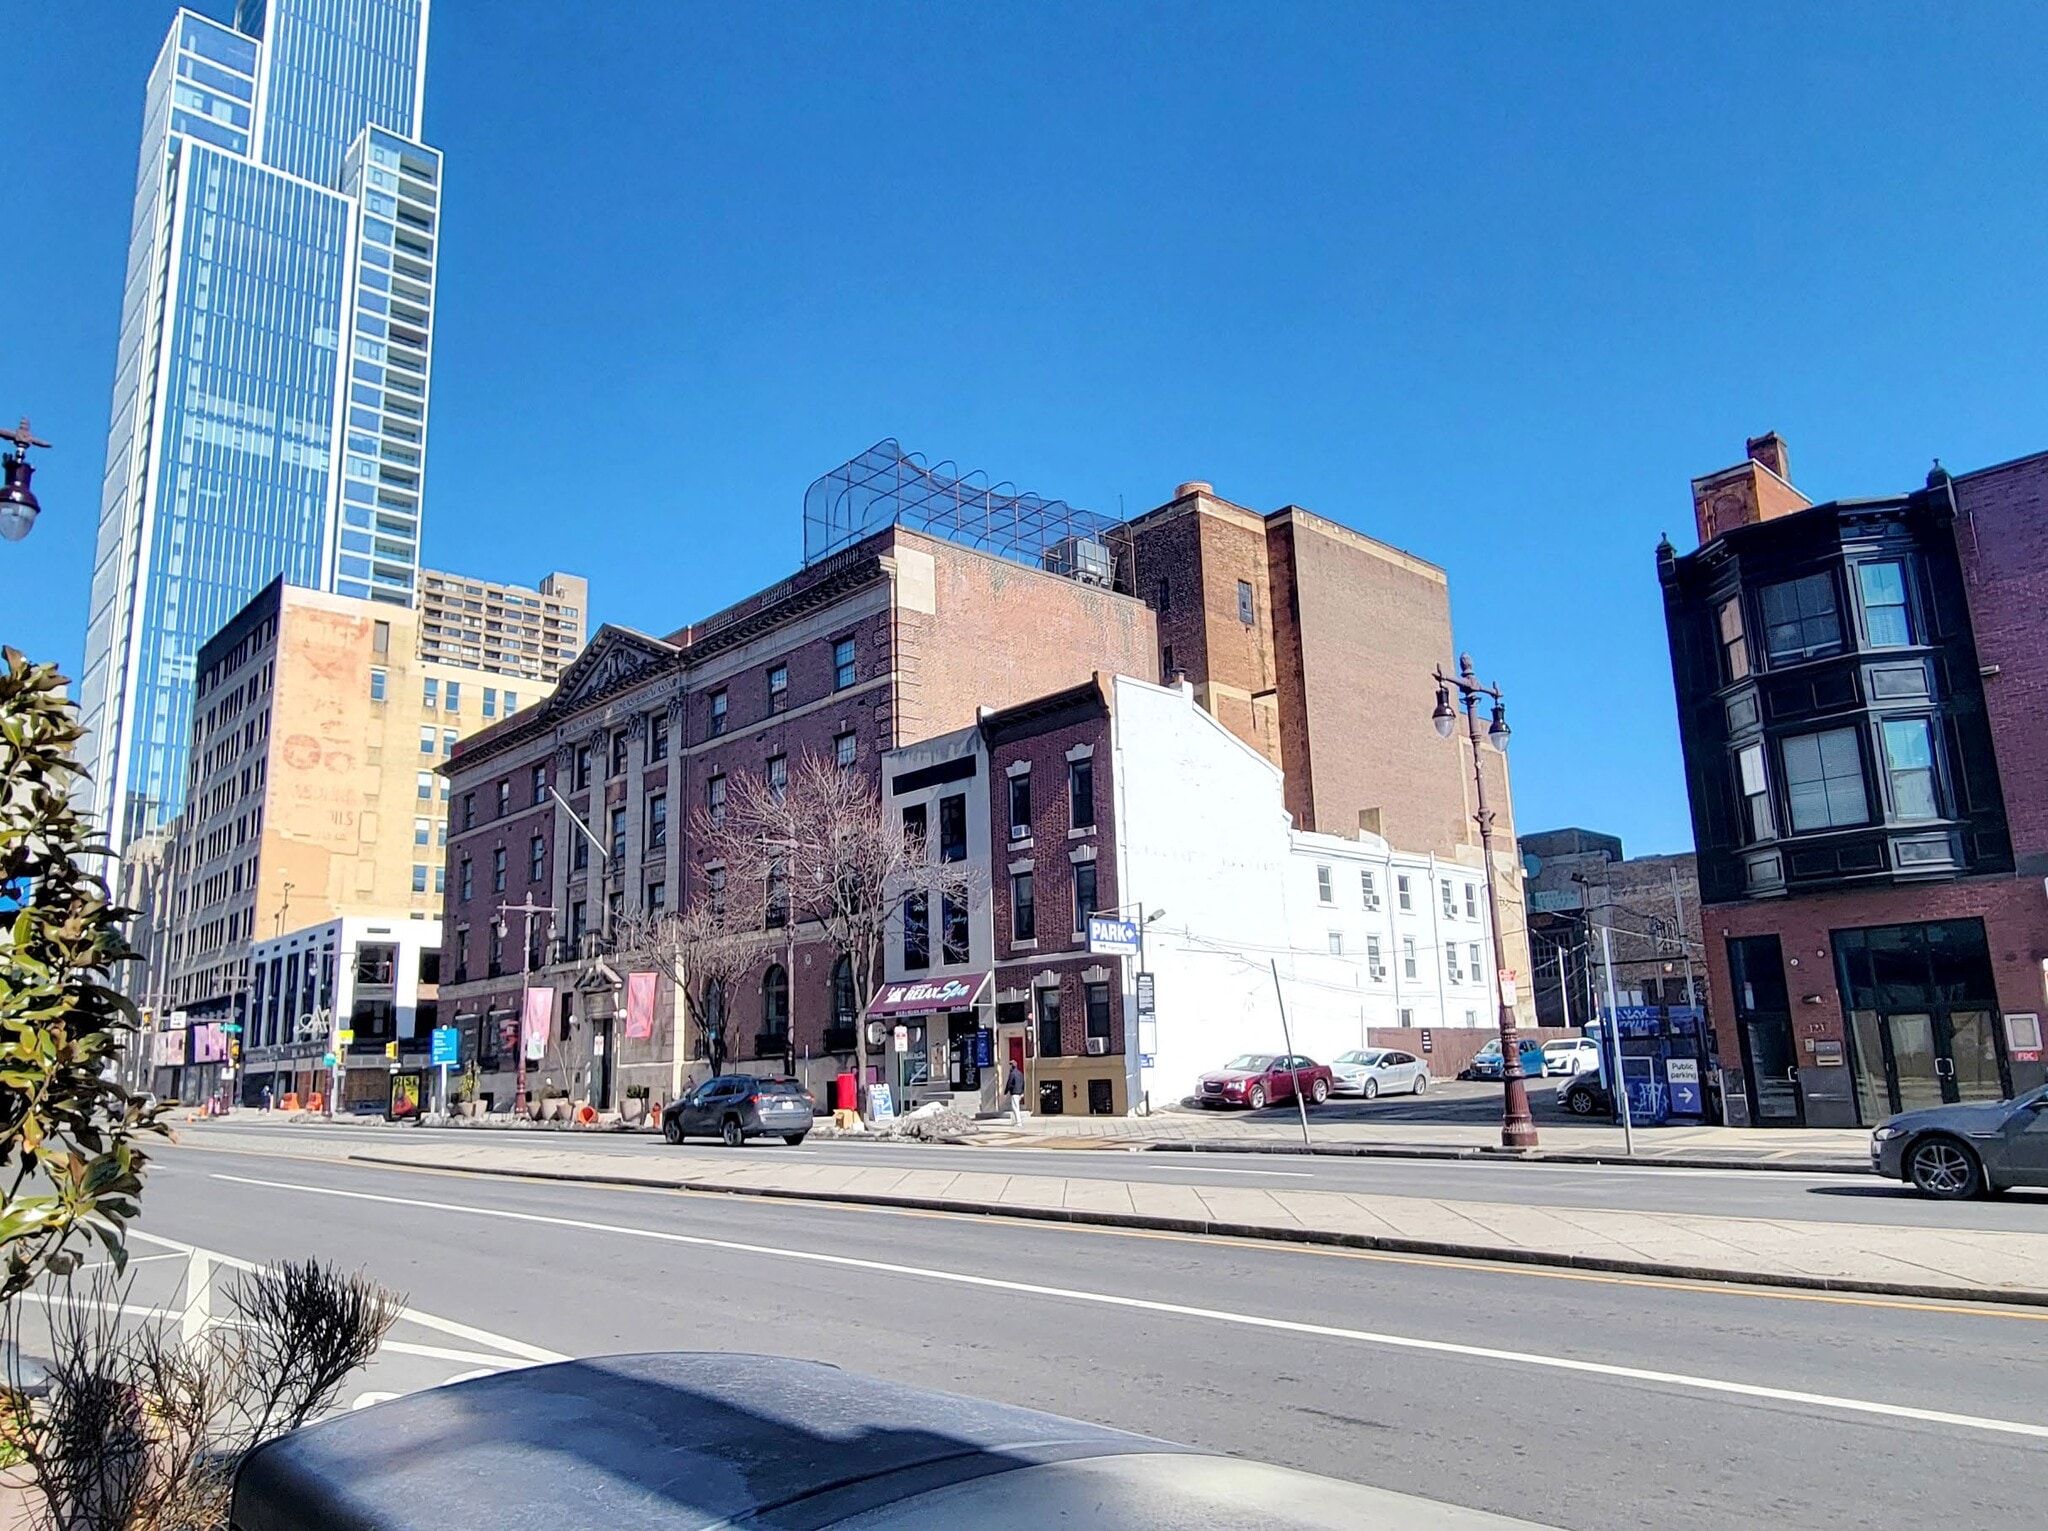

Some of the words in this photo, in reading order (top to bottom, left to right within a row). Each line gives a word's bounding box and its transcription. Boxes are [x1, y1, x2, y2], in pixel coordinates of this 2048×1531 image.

[1091, 921, 1128, 942] PARK
[903, 986, 942, 1002] RELAX
[936, 980, 970, 1002] Spa
[1671, 1062, 1694, 1070] Public
[1671, 1071, 1697, 1080] parking
